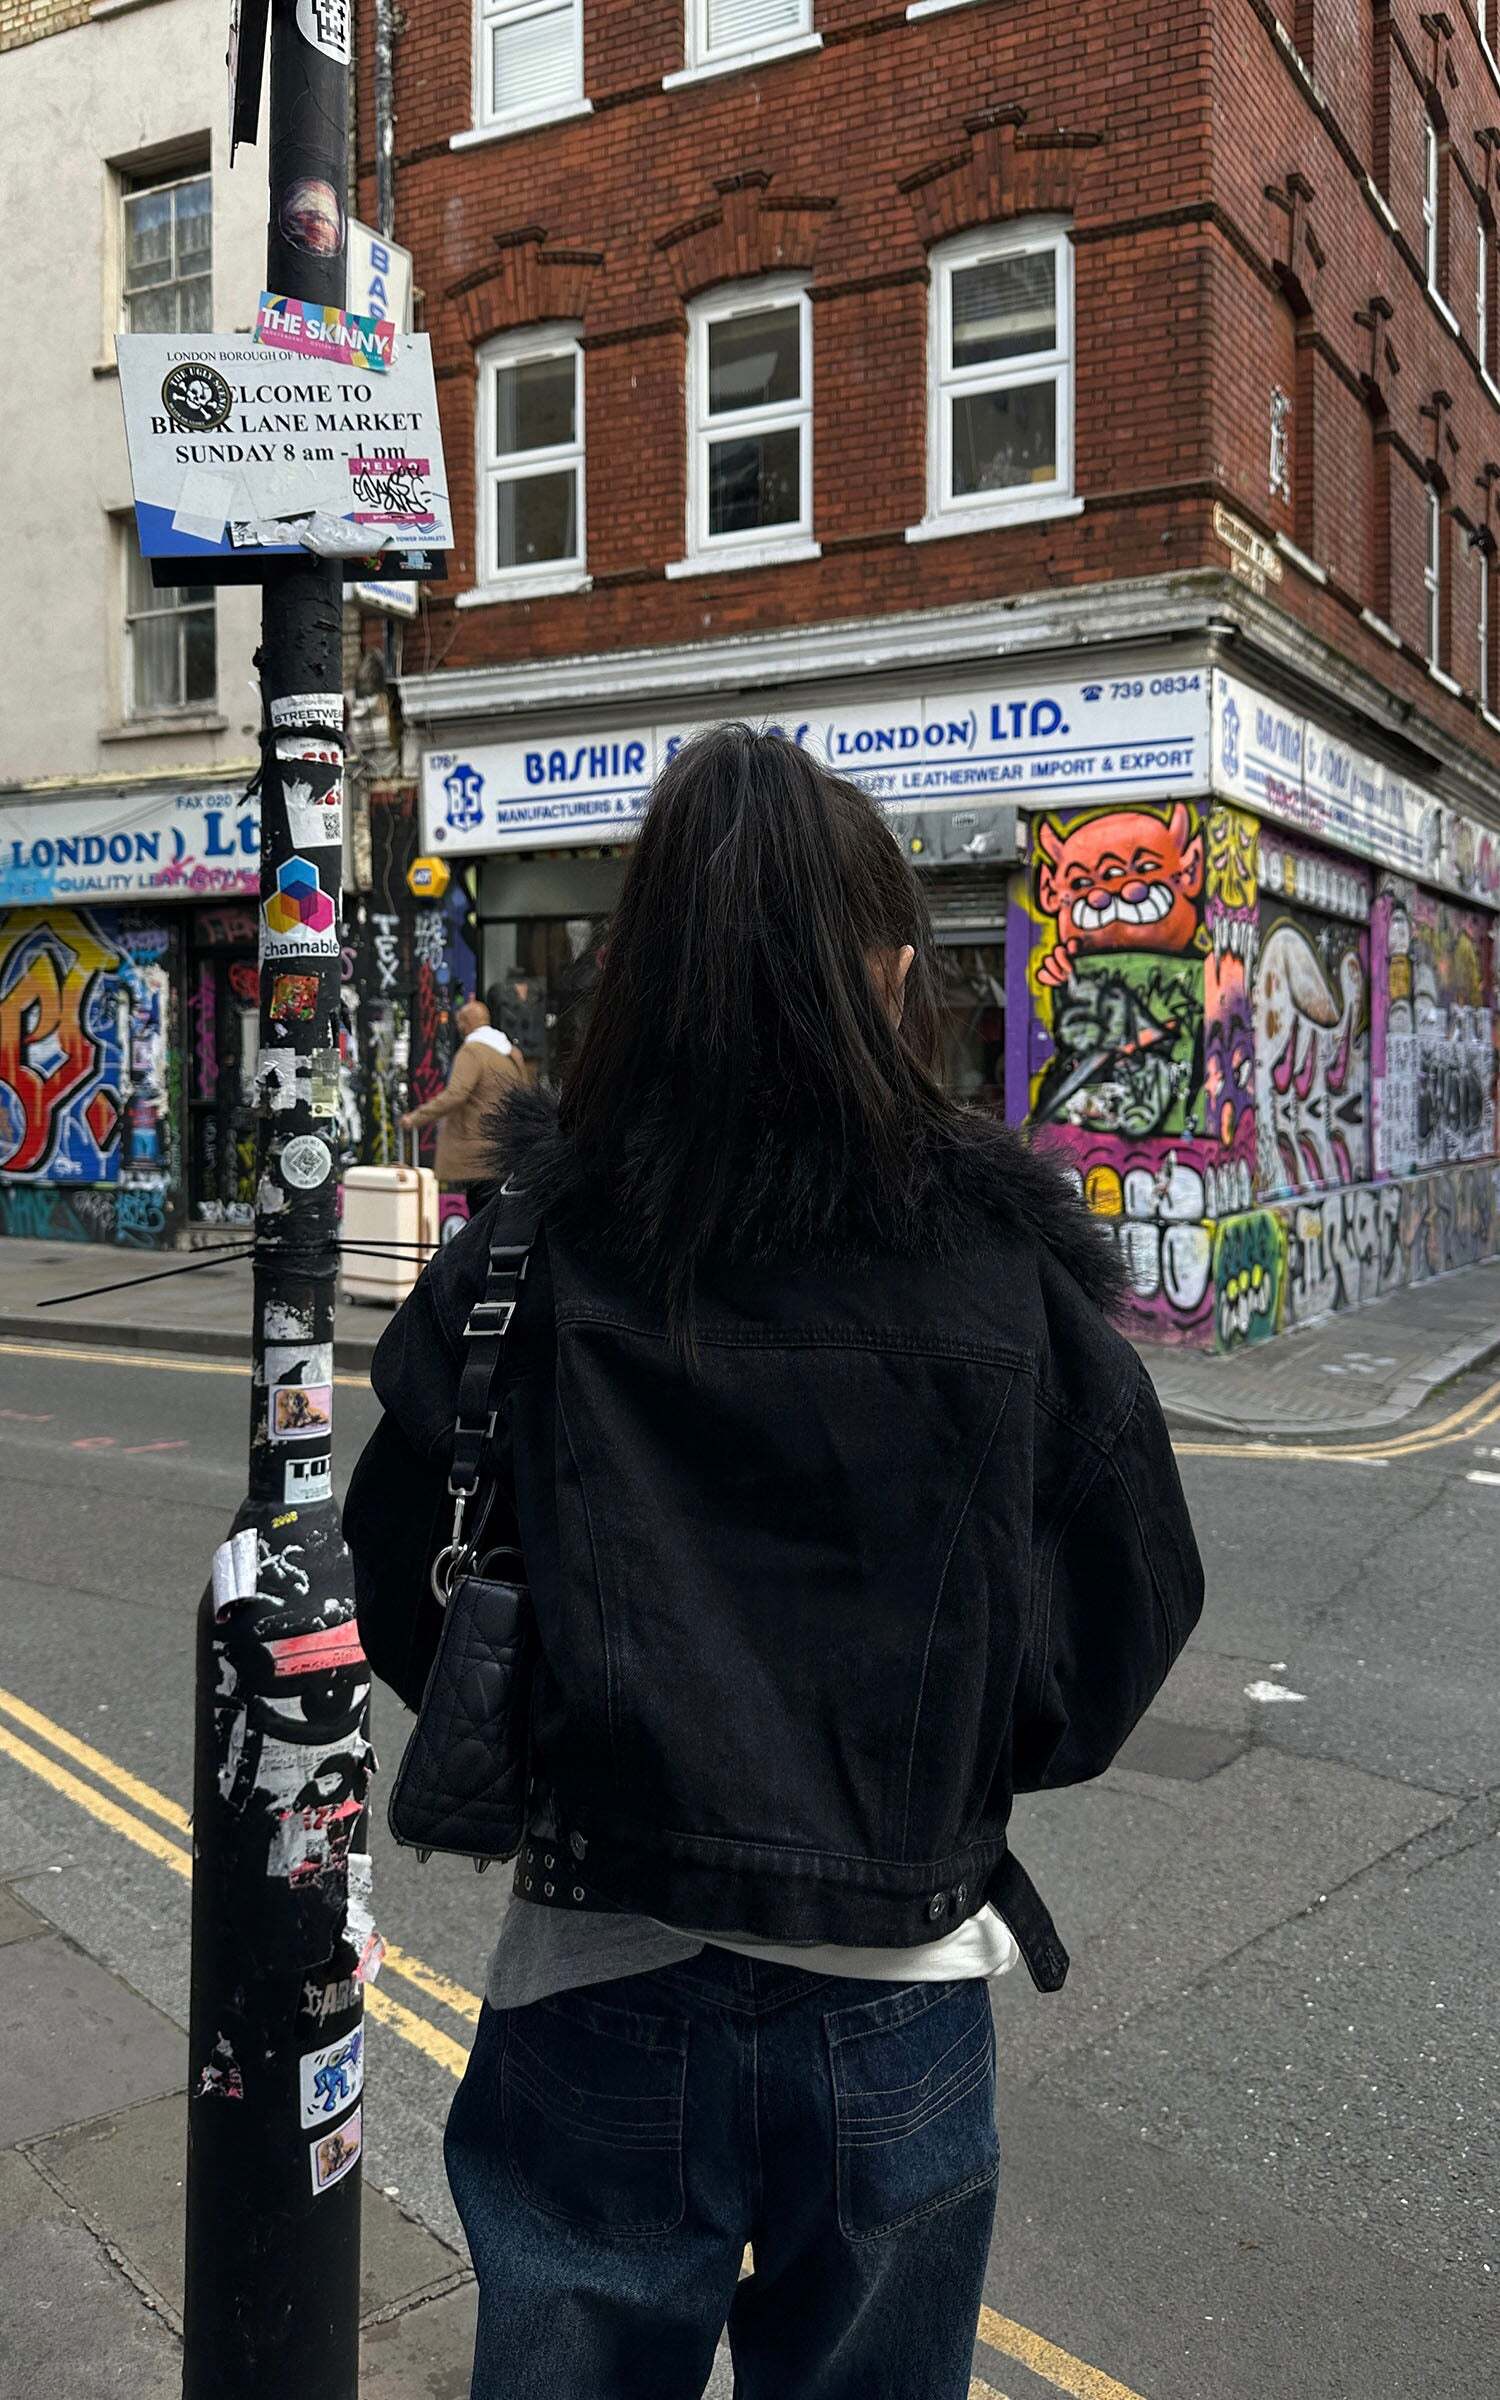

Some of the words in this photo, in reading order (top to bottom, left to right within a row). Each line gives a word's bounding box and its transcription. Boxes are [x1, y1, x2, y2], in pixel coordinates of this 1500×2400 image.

[261, 307, 302, 336] THE
[305, 319, 389, 355] SKINNY
[167, 351, 216, 362] LONDON
[220, 351, 276, 361] BOROUGH
[279, 350, 294, 361] OF
[229, 385, 332, 403] ELCOME
[337, 384, 372, 403] TO
[241, 414, 309, 433] LANE
[316, 412, 423, 432] MARKET
[175, 445, 277, 464] SUNDAY
[283, 444, 295, 462] 8
[301, 448, 334, 462] am
[357, 443, 363, 459] 1
[361, 461, 418, 470] HELLO
[1111, 680, 1143, 699] 739
[1152, 675, 1201, 695] 0834
[826, 709, 977, 761] (LONDON)
[990, 699, 1070, 740] LTD.
[525, 740, 647, 784] BASHIR
[902, 764, 1023, 788] LEATHERWEAR
[1031, 758, 1096, 778] IMPORT
[1102, 758, 1113, 772] &
[1119, 750, 1194, 771] EXPORT
[176, 795, 203, 809] FAX
[207, 794, 232, 808] 020
[497, 799, 611, 824] MANUFACTURERS
[615, 799, 624, 813] &
[204, 811, 260, 856] Lt
[58, 874, 131, 892] QUALITY
[264, 939, 340, 958] channable
